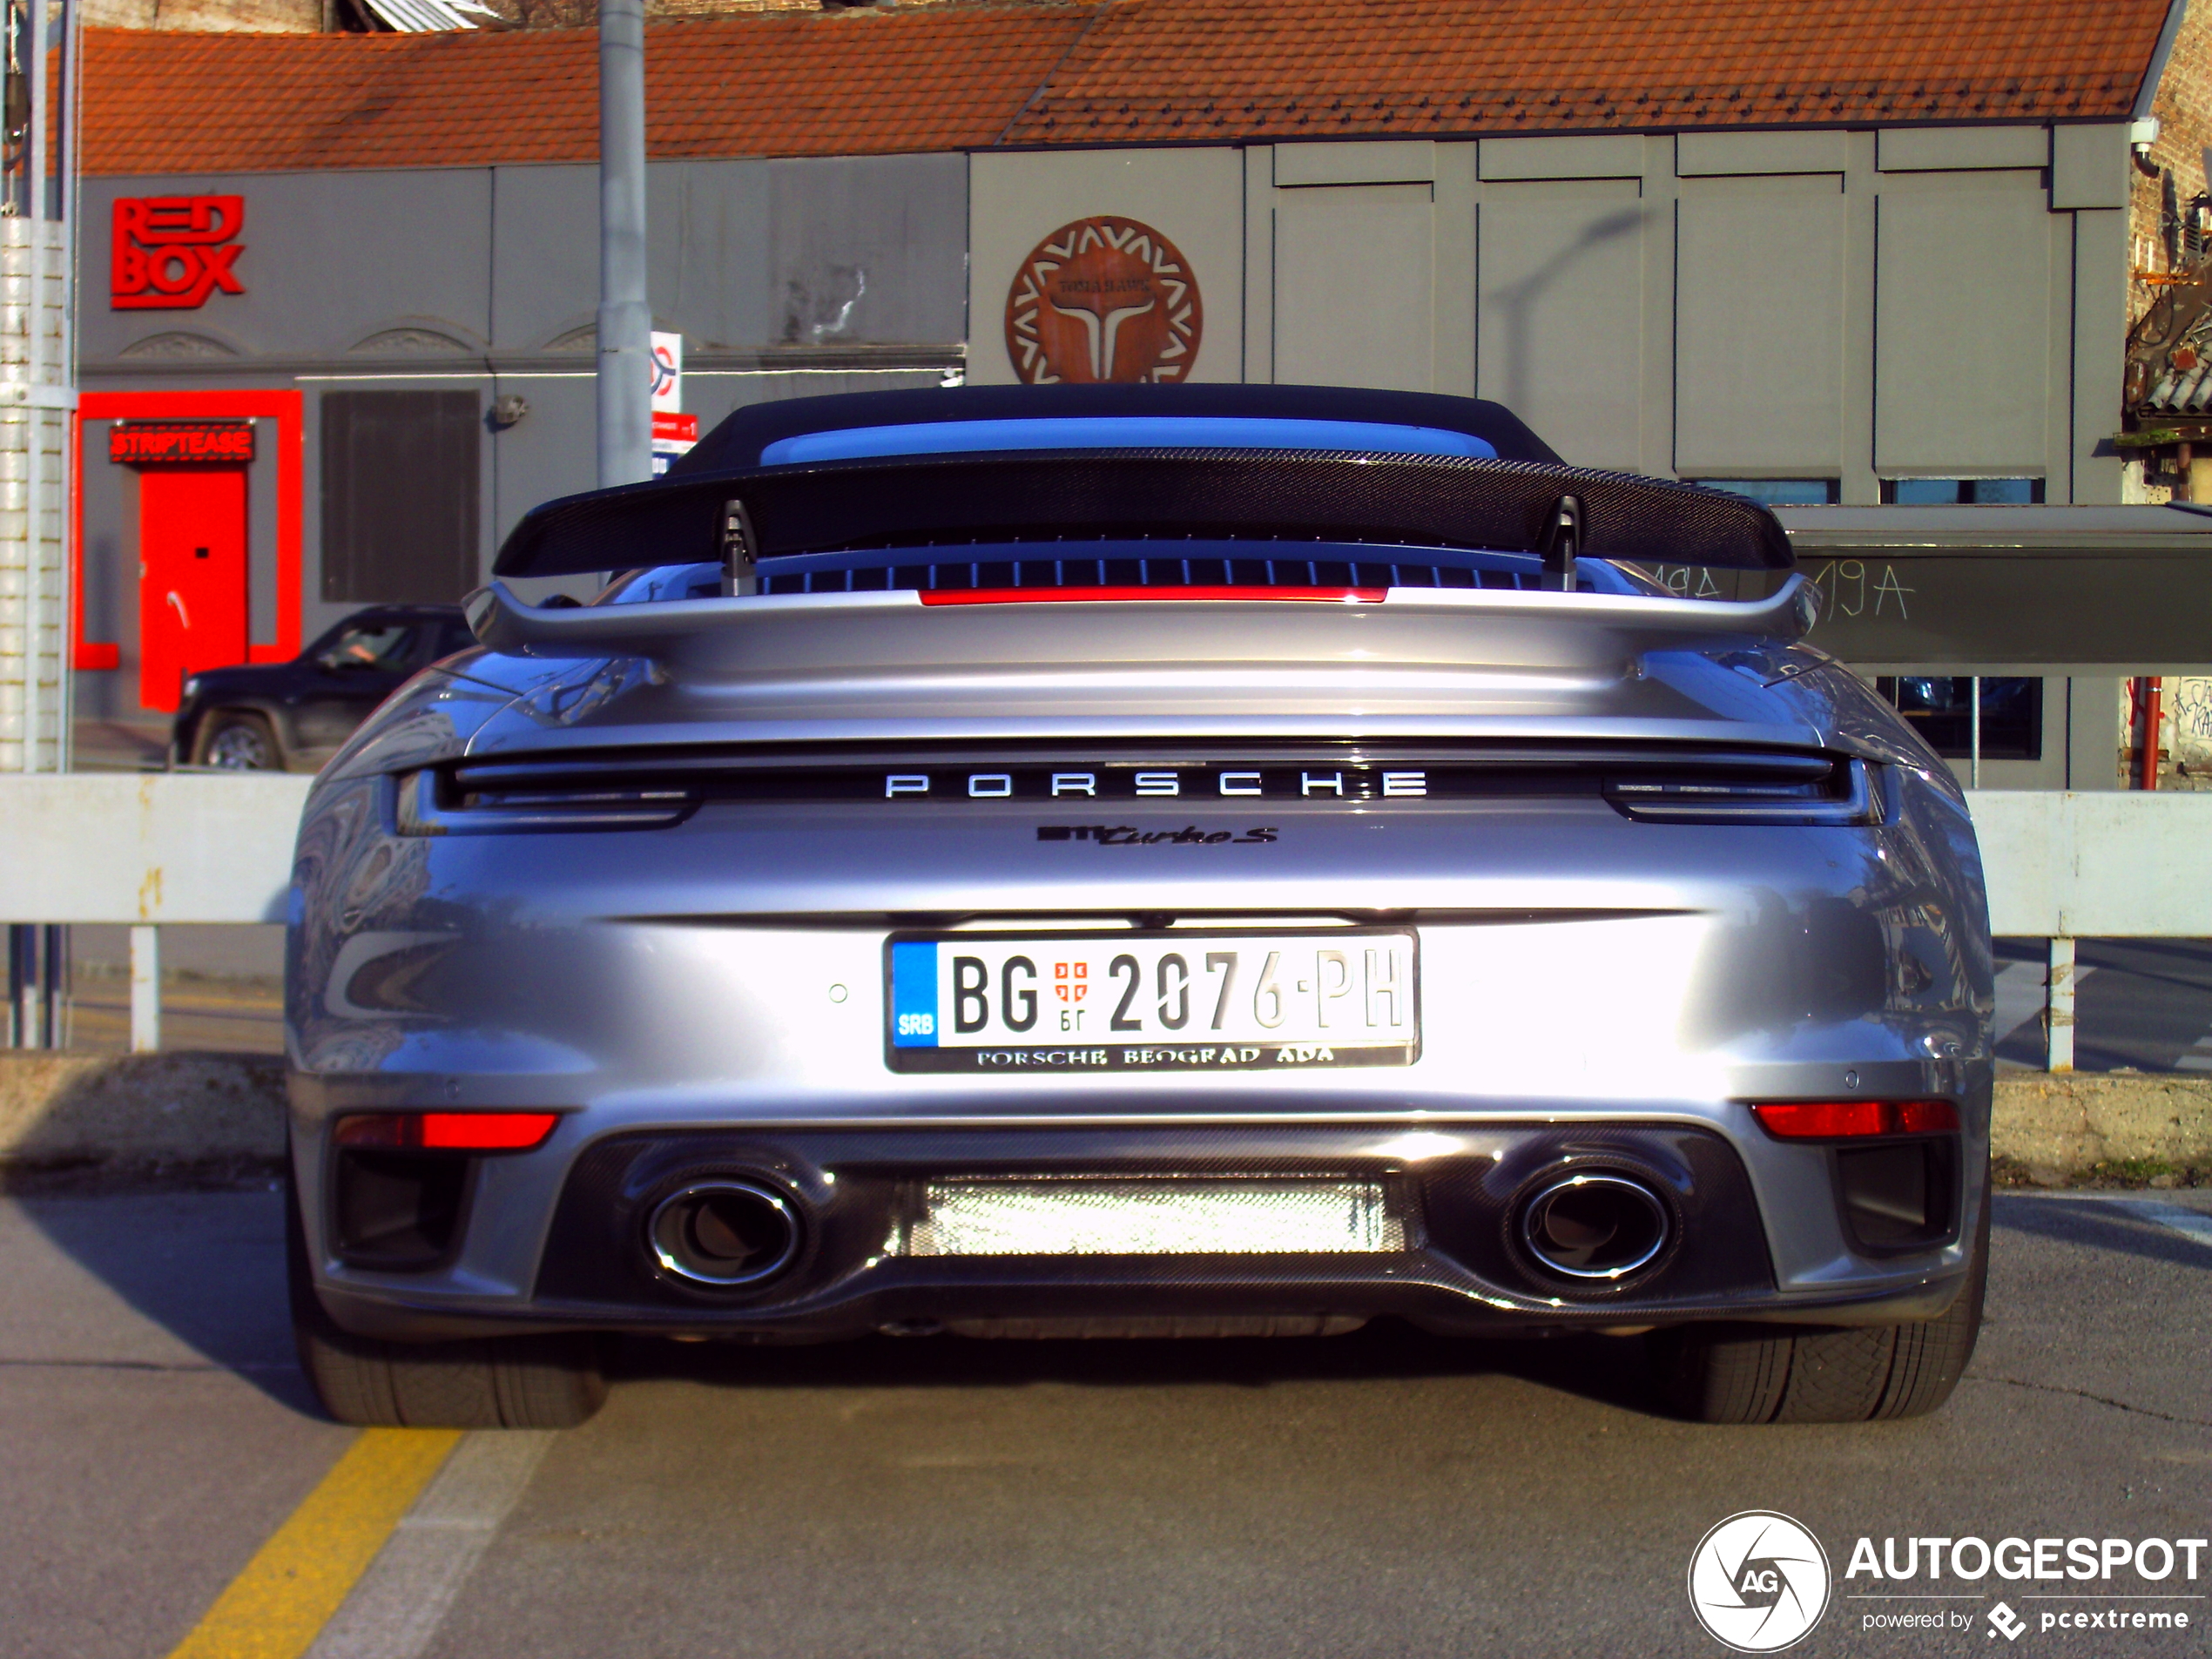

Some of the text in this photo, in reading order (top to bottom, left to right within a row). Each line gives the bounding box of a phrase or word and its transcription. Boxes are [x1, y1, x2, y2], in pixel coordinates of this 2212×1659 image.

[112, 195, 244, 246] RED
[111, 244, 246, 309] BOX
[111, 432, 251, 454] STRIPTEASE
[1816, 560, 1915, 621] 19A
[886, 772, 1428, 798] PORSCHE
[1232, 827, 1278, 843] S
[953, 954, 1038, 1034] BG
[898, 1014, 934, 1035] SRB
[1061, 1009, 1085, 1031] БГ
[977, 1048, 1334, 1066] PORSCHE BEOGRAD ADA
